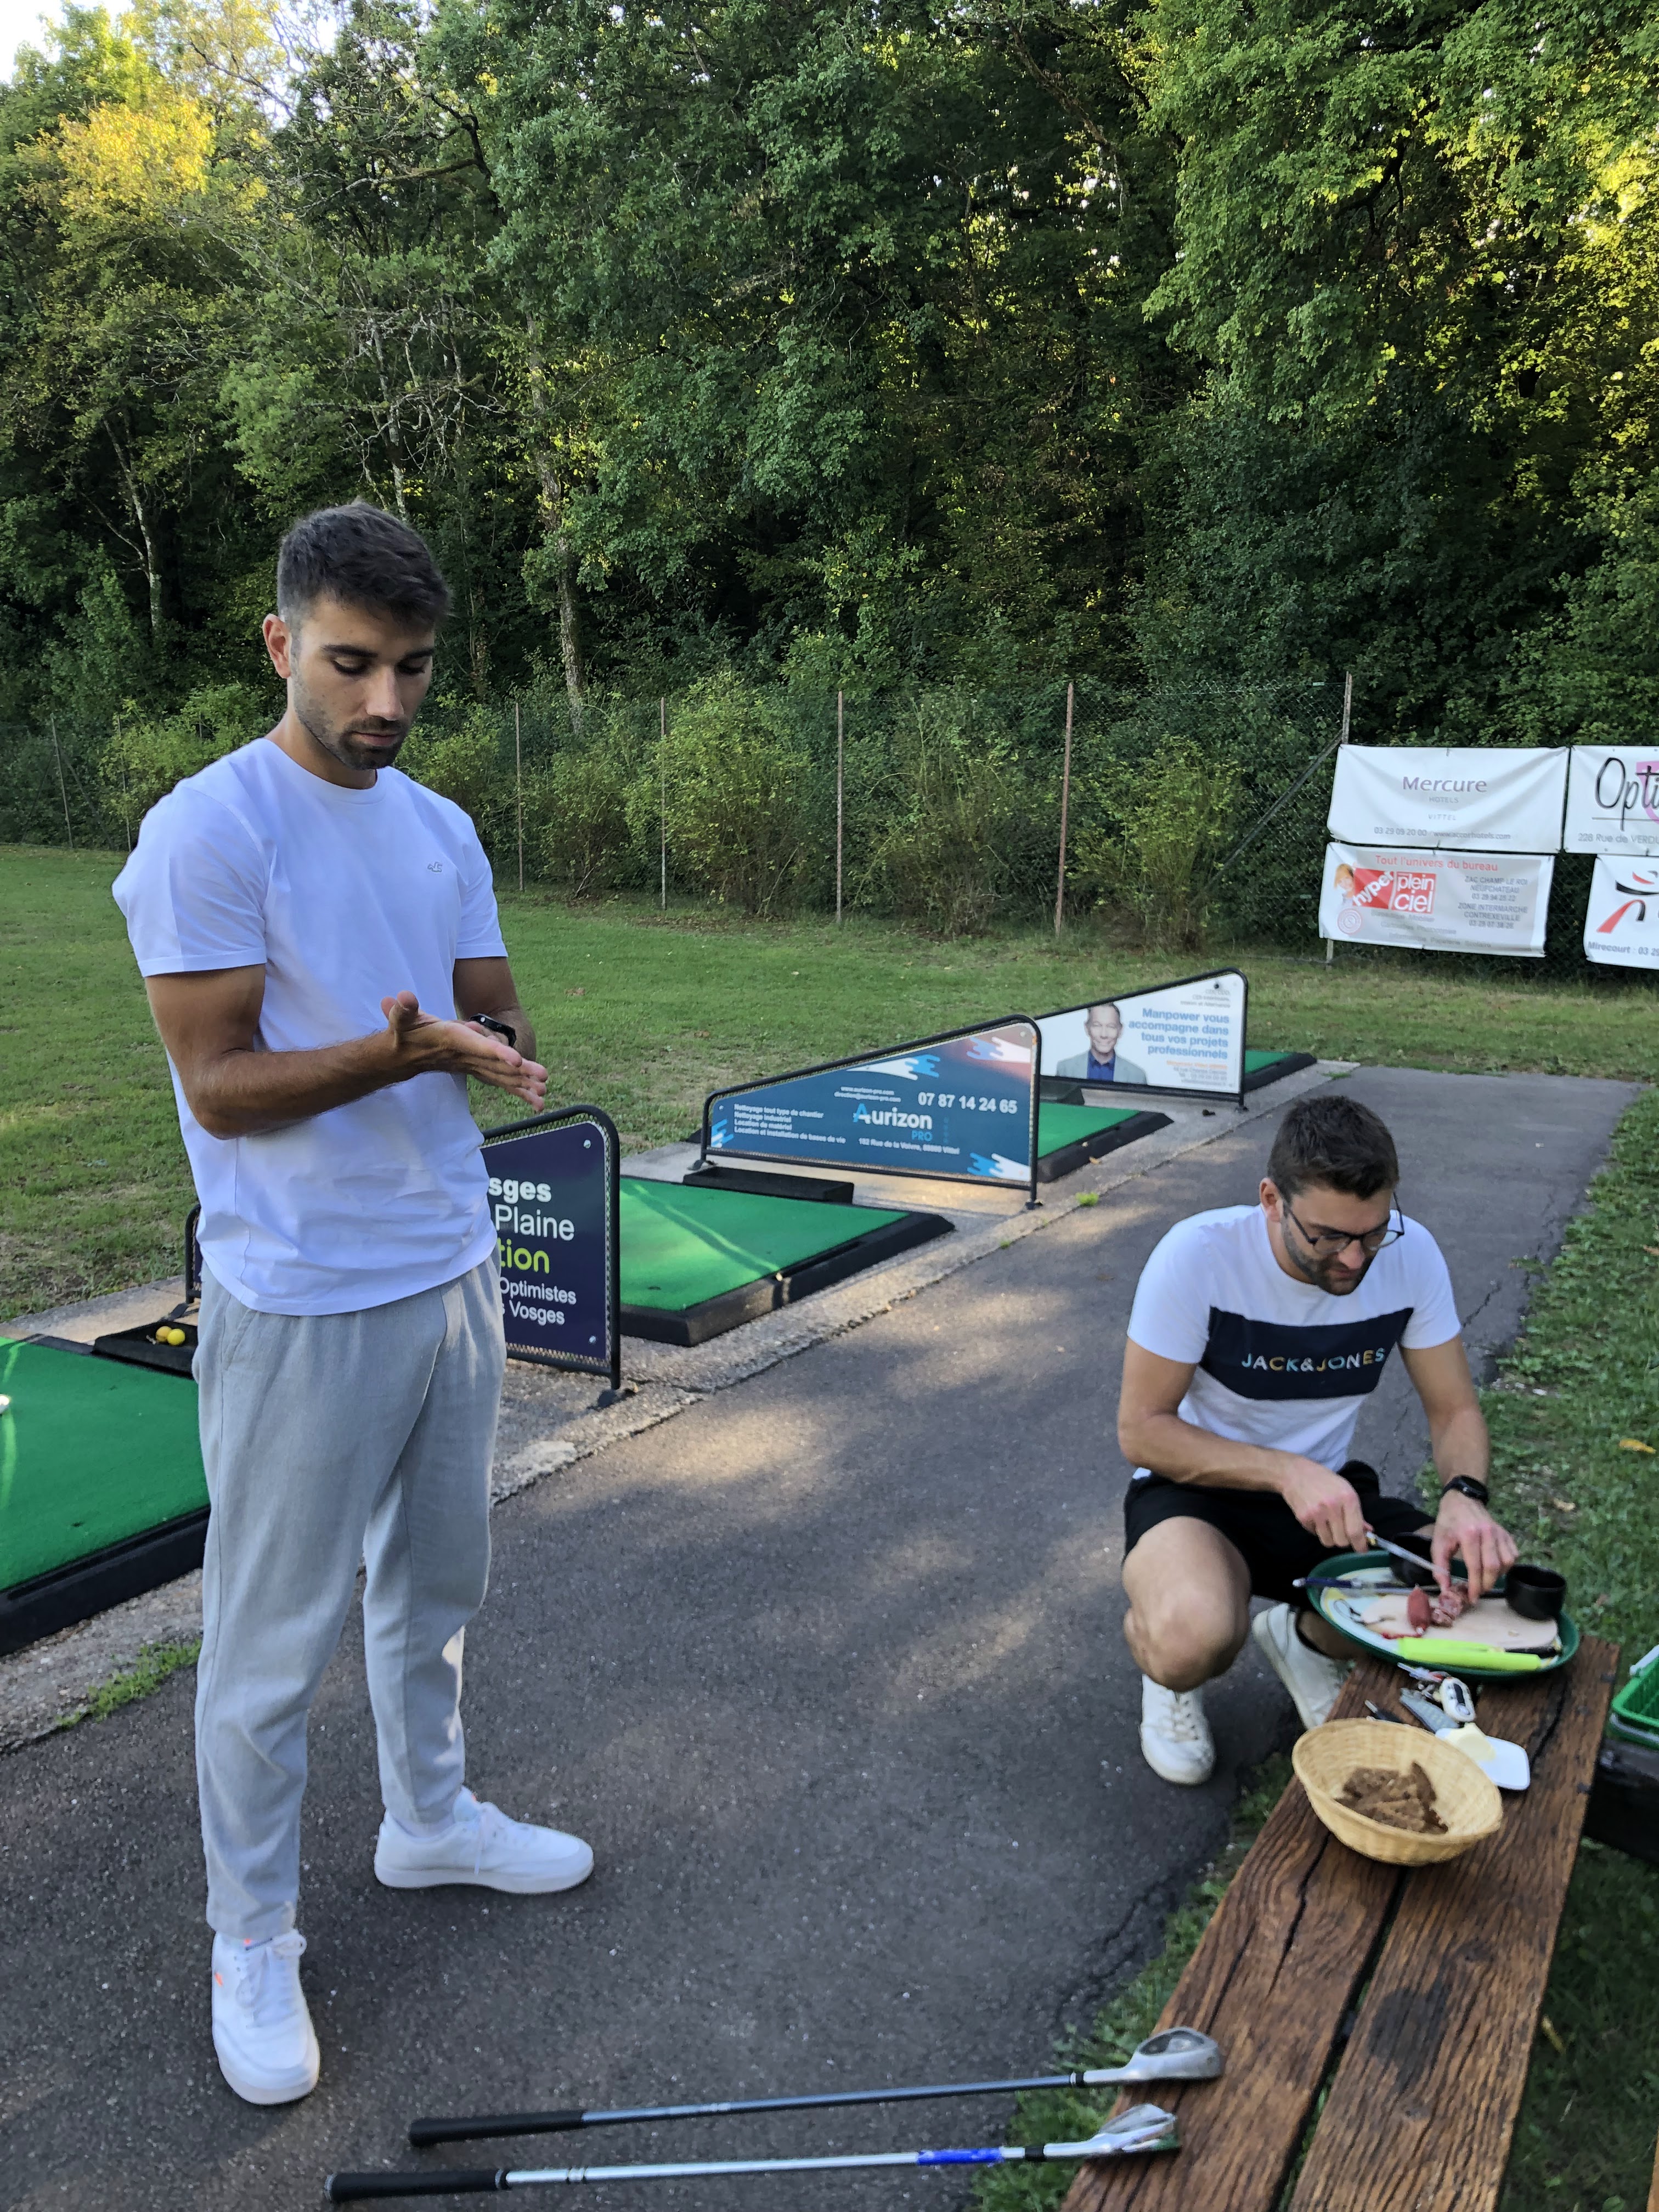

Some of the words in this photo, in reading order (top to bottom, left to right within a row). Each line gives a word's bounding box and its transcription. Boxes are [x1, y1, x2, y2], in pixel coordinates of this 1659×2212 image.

[1402, 776, 1487, 793] Mercure
[1433, 831, 1511, 839] www.accorhotels.com
[1595, 833, 1613, 843] Rue
[1615, 835, 1628, 843] de
[1376, 855, 1397, 865] Tout
[1401, 856, 1443, 868] l'univers
[1447, 860, 1459, 869] du
[1462, 860, 1498, 871] bureau
[1352, 871, 1393, 906] hyper
[1397, 873, 1434, 891] plein
[1470, 884, 1520, 894] NEUFCHATEAU
[1393, 890, 1432, 912] ciel
[1478, 904, 1528, 913] INTERMARCHE
[1464, 911, 1521, 922] CONTREXEVILLE
[1588, 941, 1630, 953] Mirecourt
[1638, 946, 1648, 955] 03
[1142, 1008, 1200, 1022] Manpower
[1204, 1014, 1229, 1023] vous
[1128, 1020, 1199, 1033] accompagne
[1202, 1024, 1229, 1036] dans
[1141, 1032, 1165, 1042] tous
[1168, 1035, 1187, 1043] vos
[1189, 1035, 1228, 1048] projets
[1148, 1046, 1228, 1060] professionnels
[734, 1103, 763, 1114] Nettoyage
[777, 1108, 790, 1116] type
[799, 1110, 824, 1119] chantier
[918, 1092, 935, 1106] 07
[938, 1093, 955, 1108] 87
[959, 1095, 976, 1110] 14
[978, 1097, 997, 1112] 24
[999, 1099, 1018, 1114] 65
[734, 1111, 763, 1121] Nettoyage
[734, 1119, 759, 1127] Location
[853, 1103, 933, 1130] Aurizon
[734, 1126, 759, 1135] Location
[799, 1132, 808, 1140] de
[808, 1133, 827, 1142] bases
[827, 1135, 836, 1143] de
[836, 1136, 847, 1144] vie
[870, 1138, 883, 1147] Rue
[884, 1140, 893, 1148] de
[911, 1130, 933, 1142] PRO
[488, 1177, 552, 1204] sges
[495, 1204, 574, 1241] Plaine
[499, 1277, 577, 1305] Optimistes
[509, 1300, 565, 1326] Vosges
[1242, 1347, 1385, 1372] JACK&JONES
